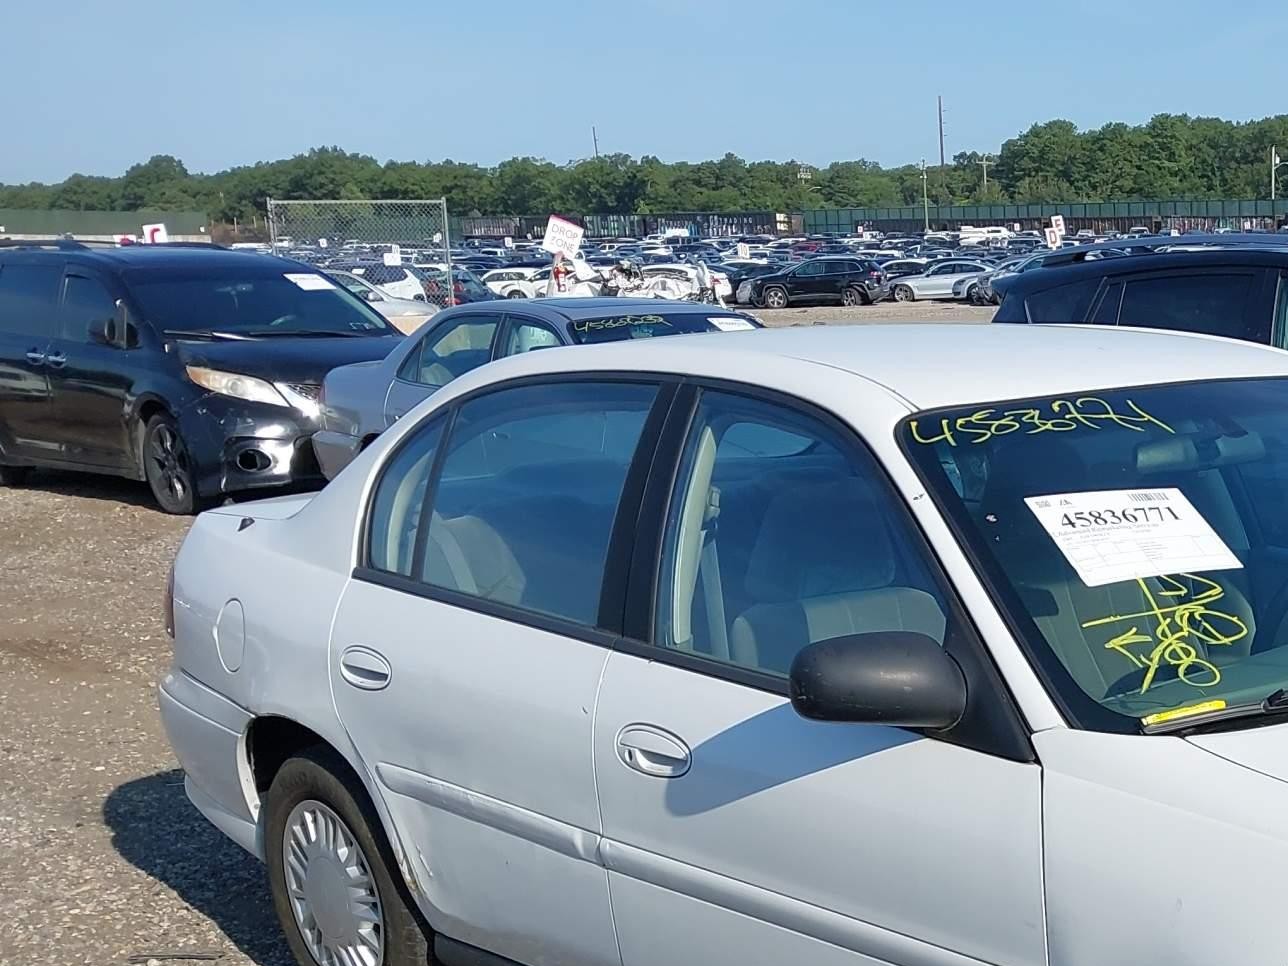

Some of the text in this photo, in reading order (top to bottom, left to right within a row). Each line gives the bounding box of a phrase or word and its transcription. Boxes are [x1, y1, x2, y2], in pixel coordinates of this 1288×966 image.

[551, 223, 579, 239] DROP
[550, 236, 575, 253] ZONE
[1061, 506, 1184, 529] 45836771
